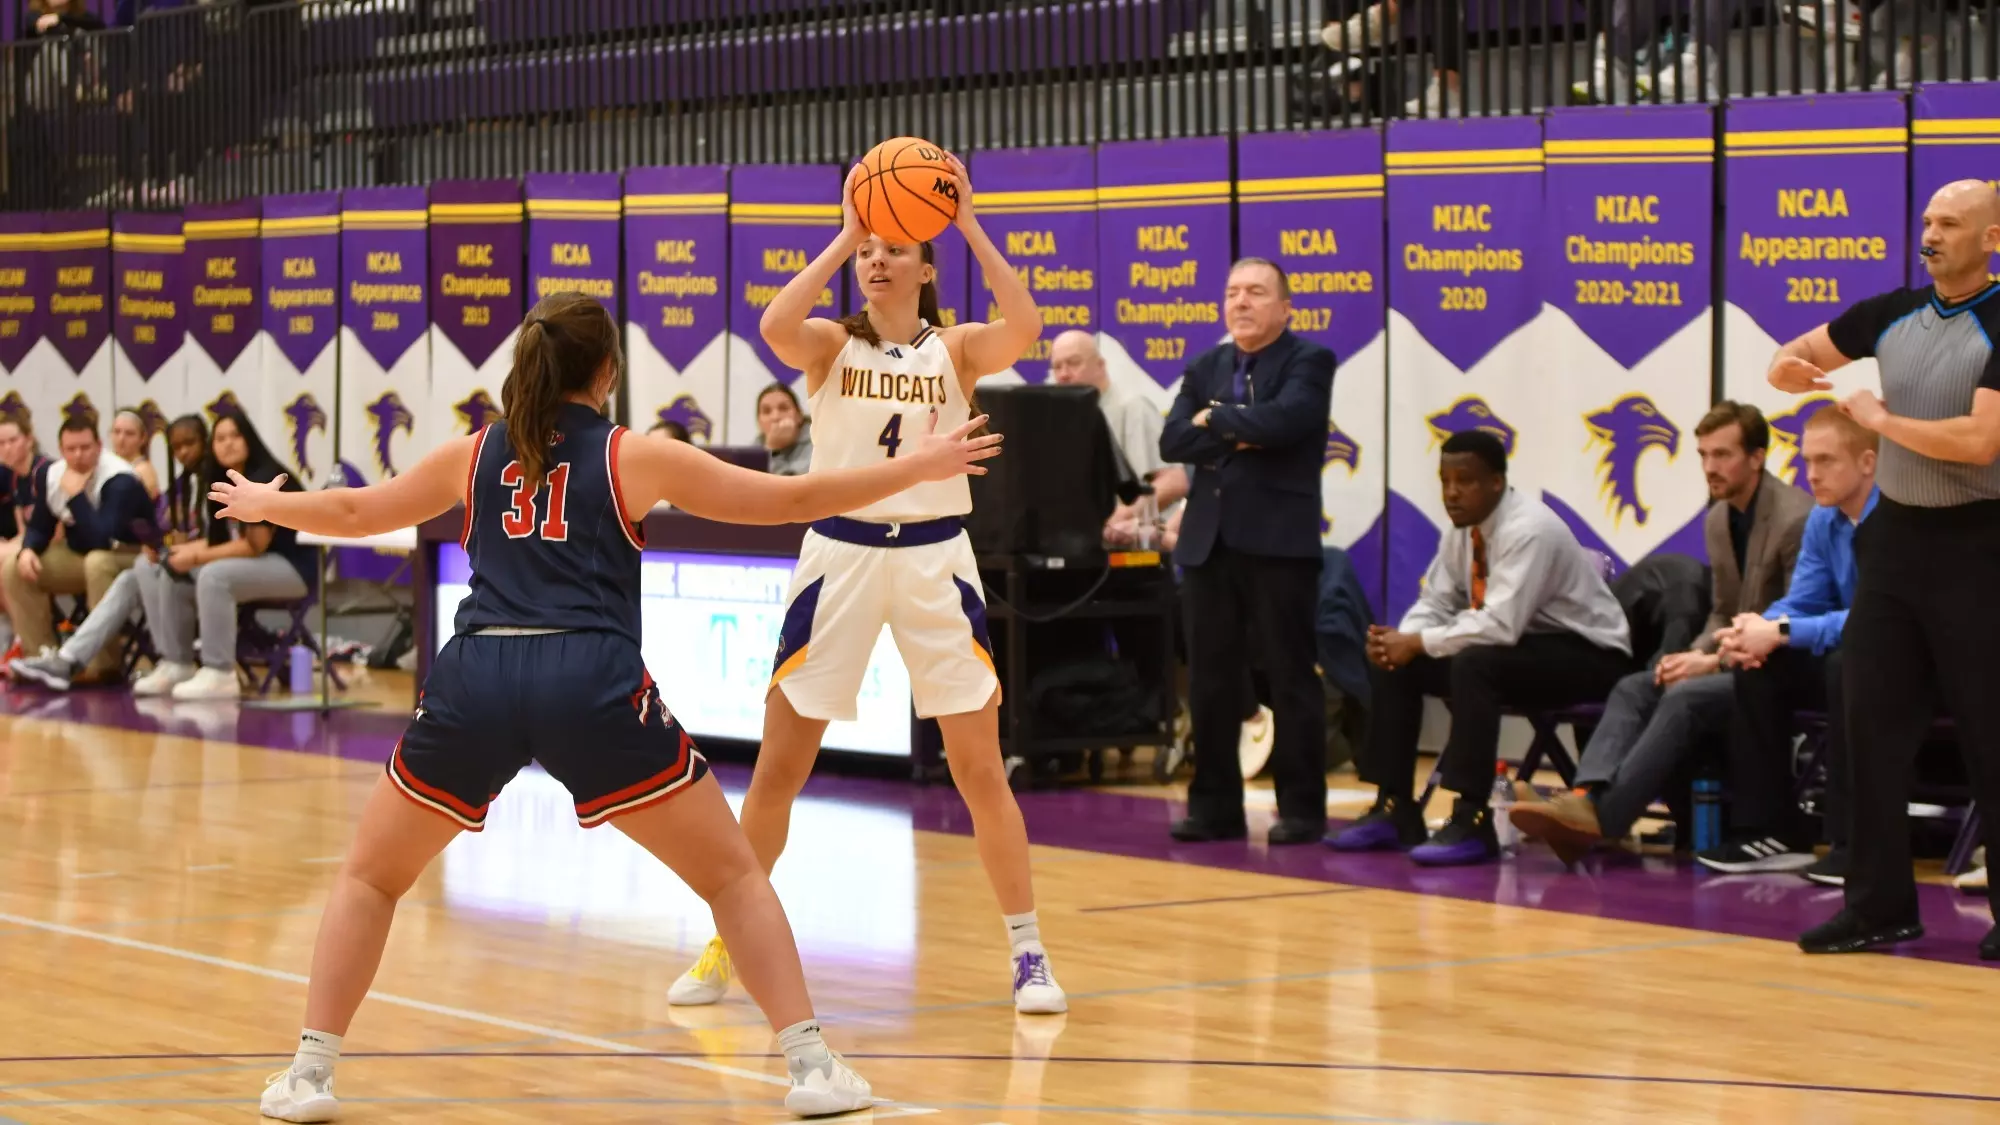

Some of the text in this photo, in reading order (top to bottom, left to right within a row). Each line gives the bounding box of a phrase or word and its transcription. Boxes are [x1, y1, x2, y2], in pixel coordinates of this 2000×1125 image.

[1596, 196, 1658, 223] MIAC
[1778, 189, 1848, 218] NCAA
[1433, 204, 1491, 231] MIAC
[1007, 232, 1056, 256] NCAA
[1138, 225, 1188, 251] MIAC
[1281, 230, 1337, 256] NCAA
[1741, 234, 1886, 265] Appearance
[367, 253, 401, 273] NCAA
[457, 244, 493, 267] MIAC
[552, 244, 591, 265] NCAA
[656, 241, 694, 262] MIAC
[763, 249, 807, 272] NCAA
[1405, 244, 1523, 275] Champions
[1567, 236, 1694, 268] Champions
[284, 259, 315, 277] NCAA
[1033, 266, 1093, 290] Series
[1130, 261, 1196, 291] Playoff
[352, 280, 421, 304] Appearance
[442, 273, 511, 299] Champions
[639, 272, 717, 296] Champions
[1288, 271, 1373, 293] earance
[1577, 280, 1681, 305] 2020-2021
[1787, 278, 1839, 303] 2021
[194, 285, 253, 307] Champions
[270, 286, 334, 310] Appearance
[1441, 287, 1486, 310] 2020
[663, 308, 693, 326] 2016
[1118, 299, 1219, 326] Champions
[1289, 309, 1331, 331] 2017
[1146, 338, 1185, 359] 2017
[840, 366, 947, 405] WILDCATS
[878, 412, 903, 458] 4
[500, 459, 571, 542] 31
